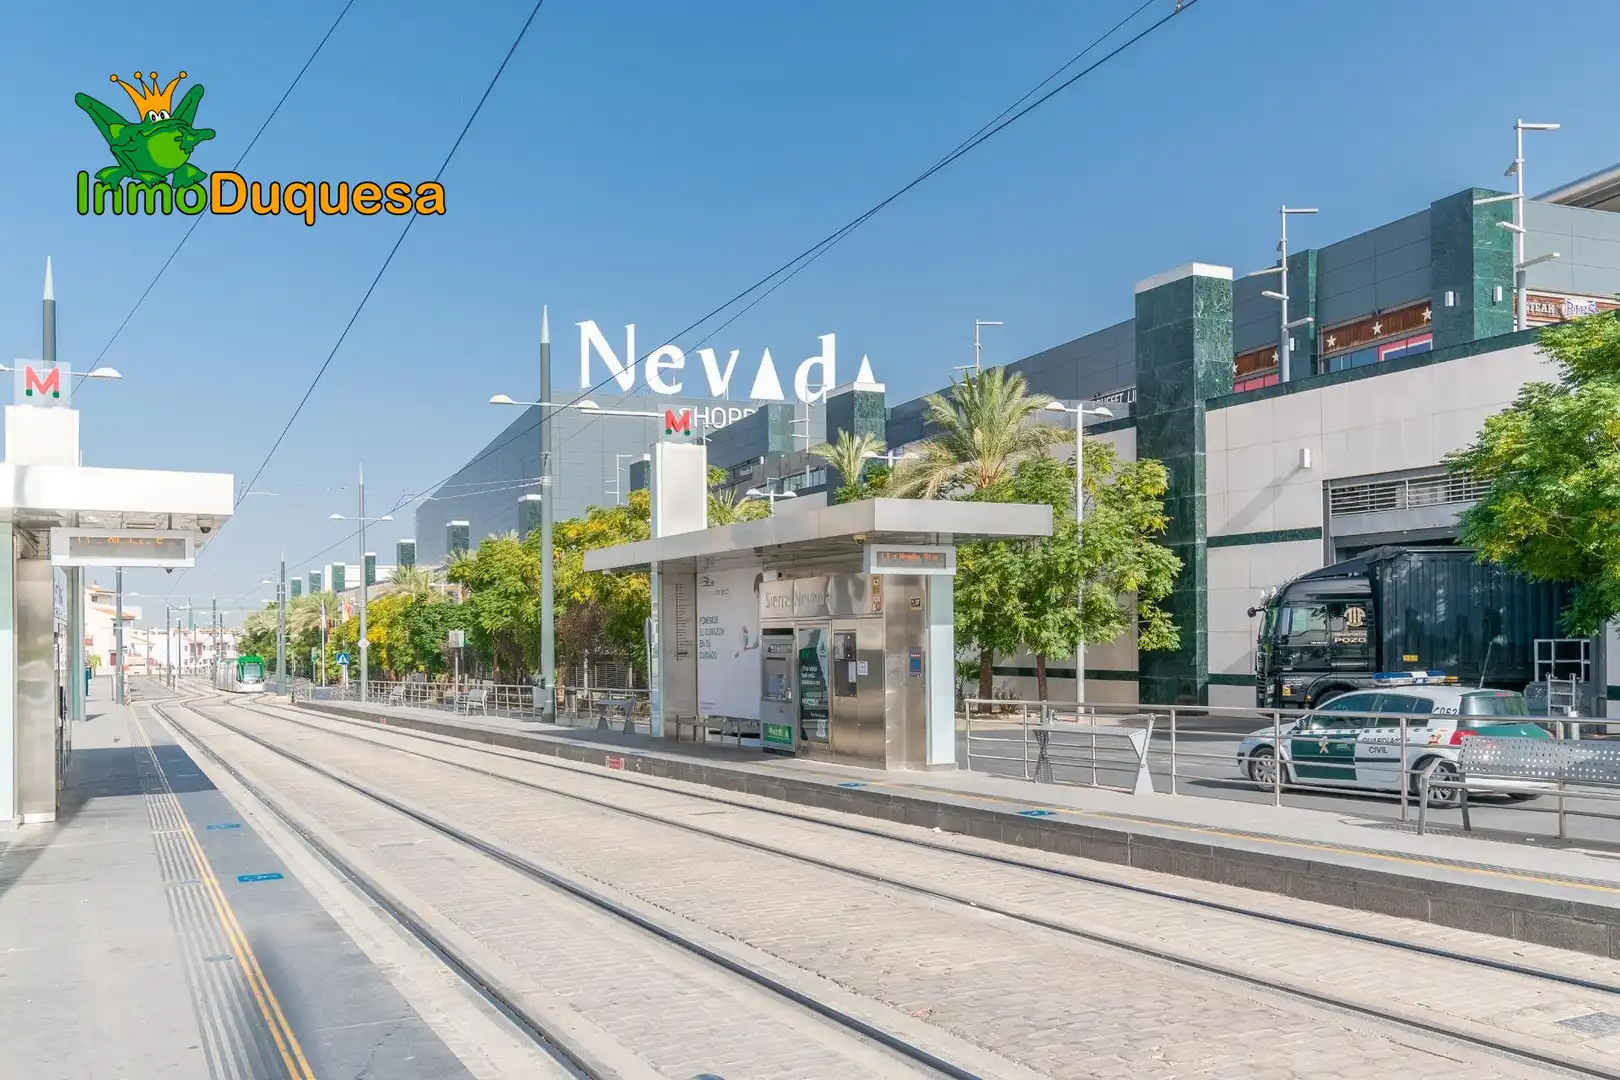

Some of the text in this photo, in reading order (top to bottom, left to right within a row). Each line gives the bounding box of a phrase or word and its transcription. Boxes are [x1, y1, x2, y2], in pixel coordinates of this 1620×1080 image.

[25, 364, 60, 398] M
[665, 403, 691, 436] M
[1368, 746, 1388, 754] CIVIL
